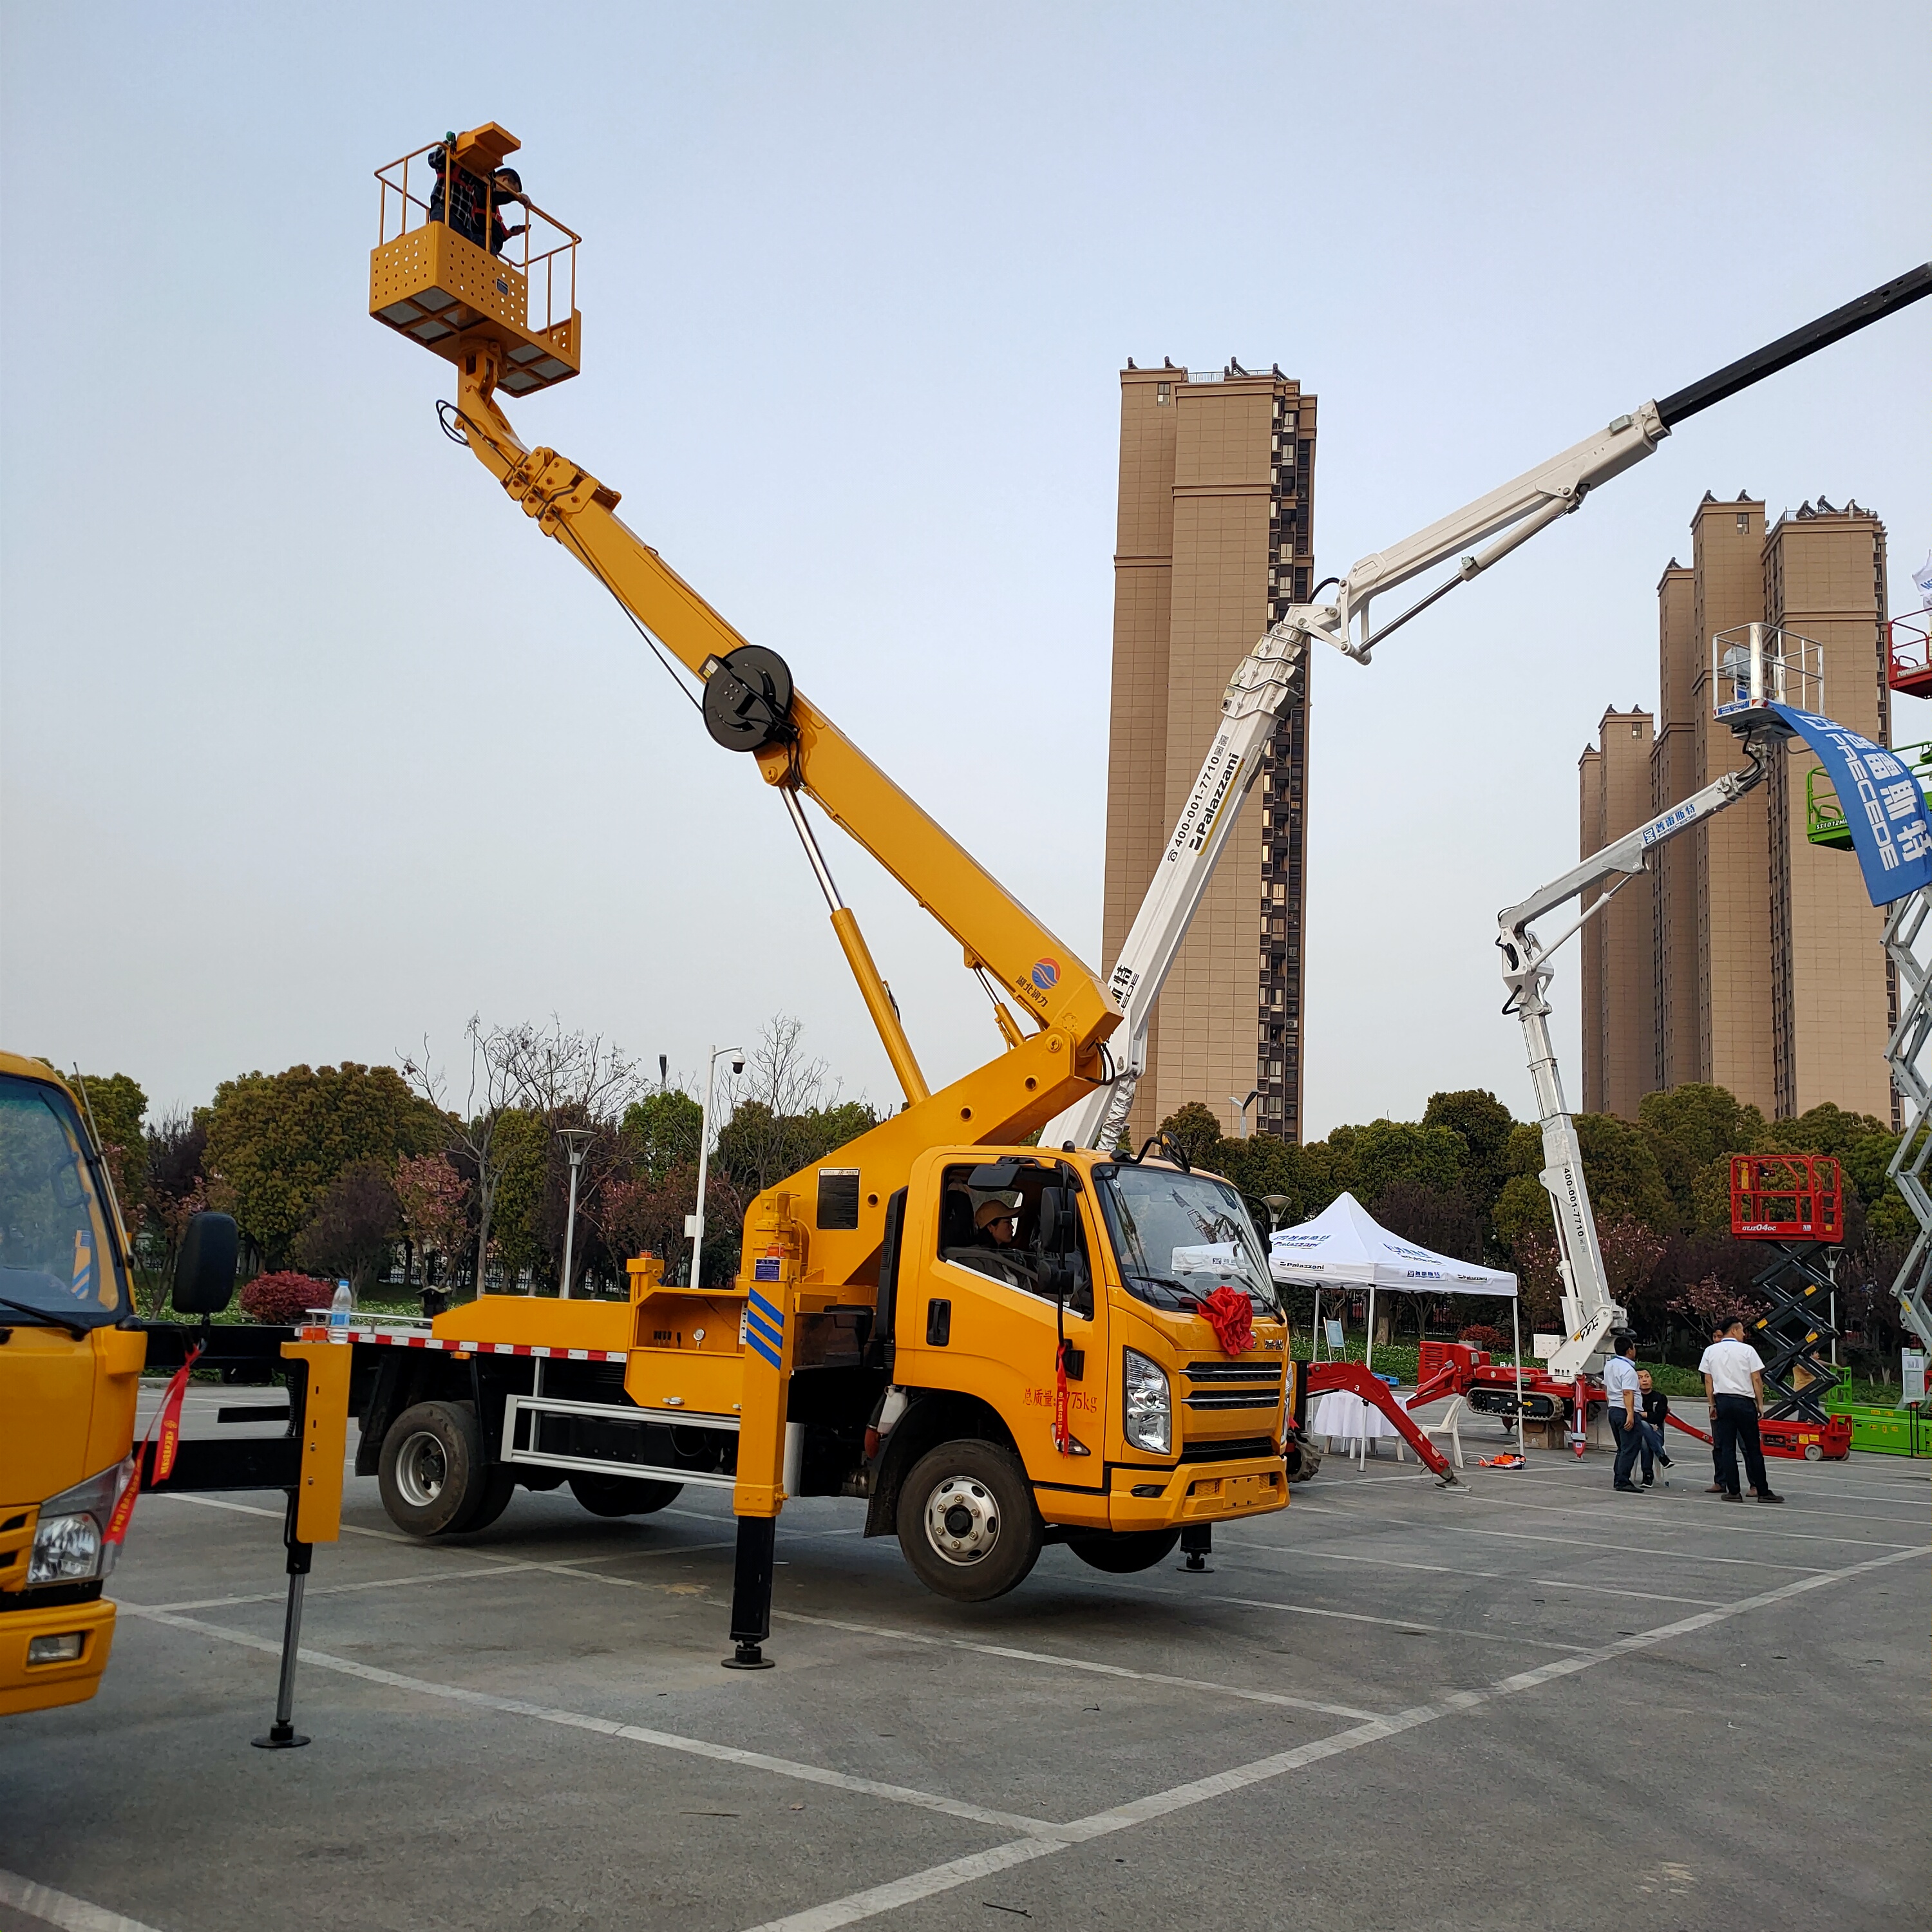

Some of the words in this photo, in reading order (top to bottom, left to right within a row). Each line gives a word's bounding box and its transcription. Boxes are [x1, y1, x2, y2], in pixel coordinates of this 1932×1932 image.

[1174, 755, 1220, 848] 400-001-7710
[1195, 752, 1240, 836] Palazzani
[1824, 733, 1900, 871] PRECEDE
[1121, 973, 1140, 1014] EDE
[1564, 1168, 1584, 1238] 400-001-7710
[1580, 1314, 1599, 1342] 225
